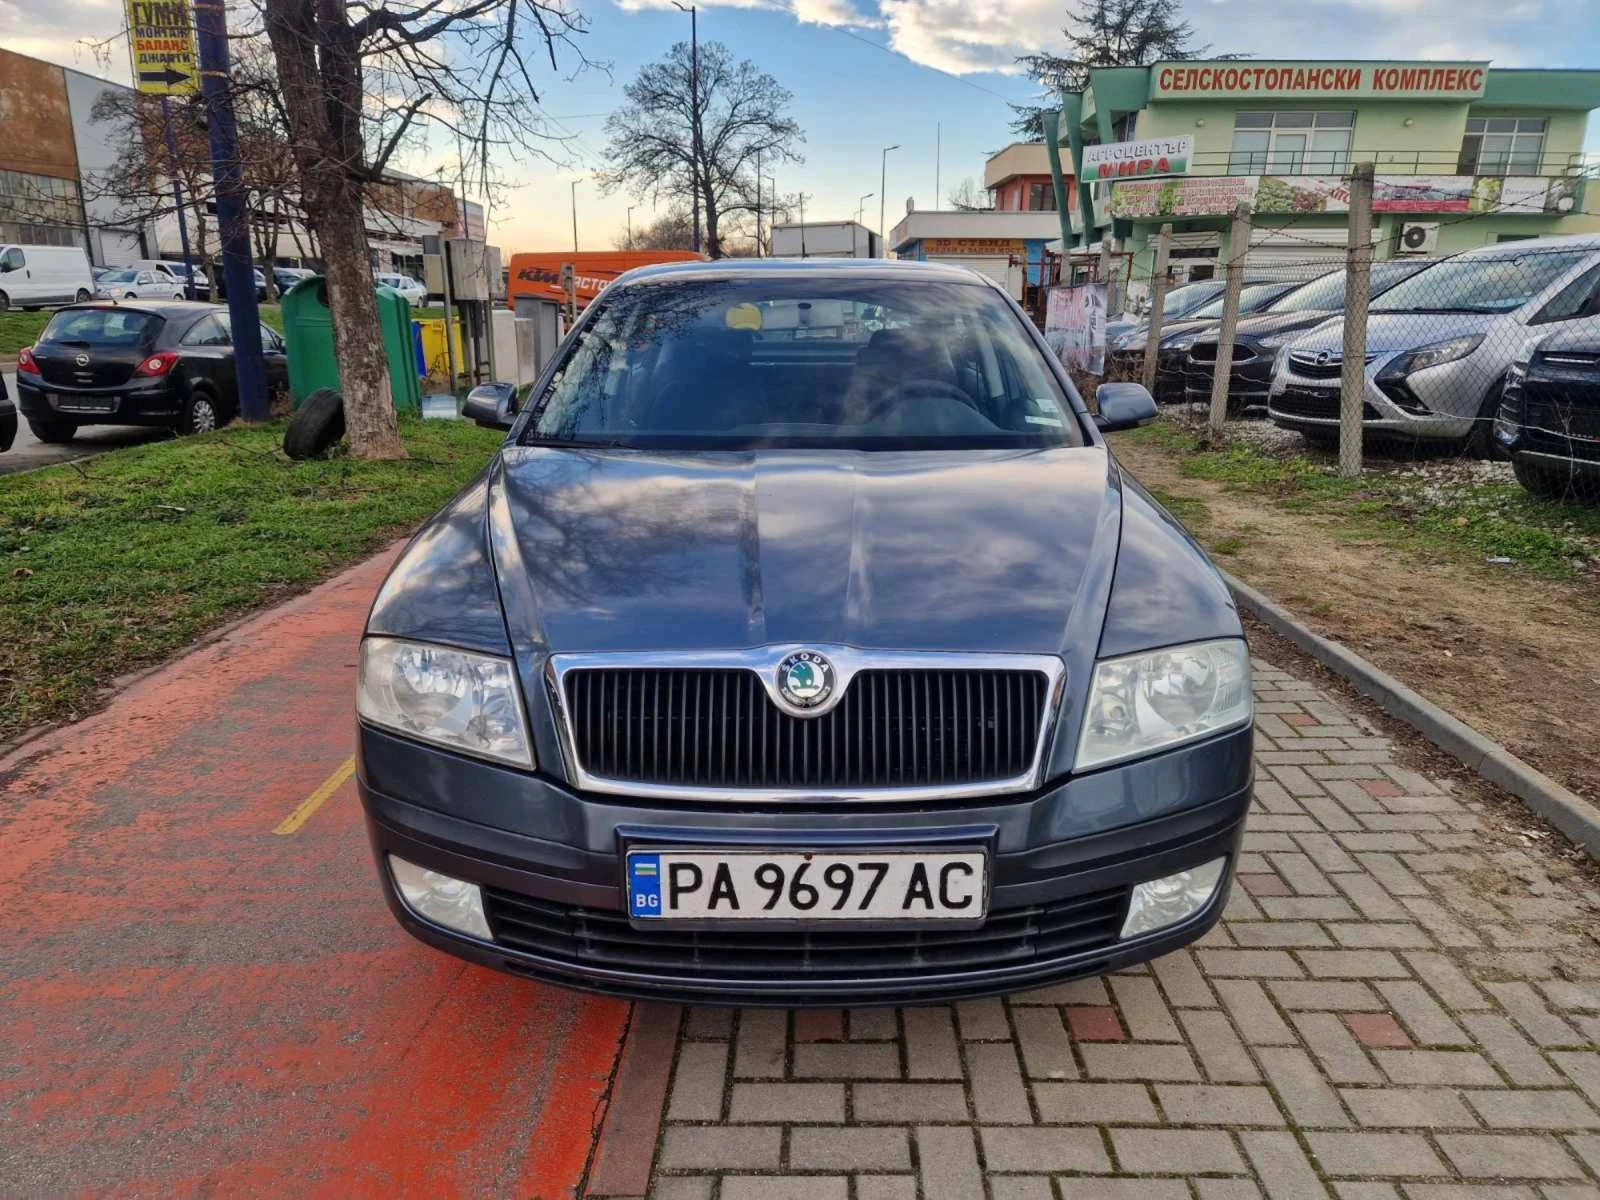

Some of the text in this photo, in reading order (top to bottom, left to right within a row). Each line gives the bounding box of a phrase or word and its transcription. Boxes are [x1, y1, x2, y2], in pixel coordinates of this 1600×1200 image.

[136, 39, 189, 51] БАЛАНС
[1159, 67, 1483, 92] СЕЛСКОСТОПАНСКИ КОМПЛЕКС
[1098, 156, 1172, 178] МИРА
[518, 267, 559, 285] KTM
[572, 275, 614, 291] ACTO
[669, 861, 974, 911] PA 9697 AC
[635, 893, 658, 908] BG
